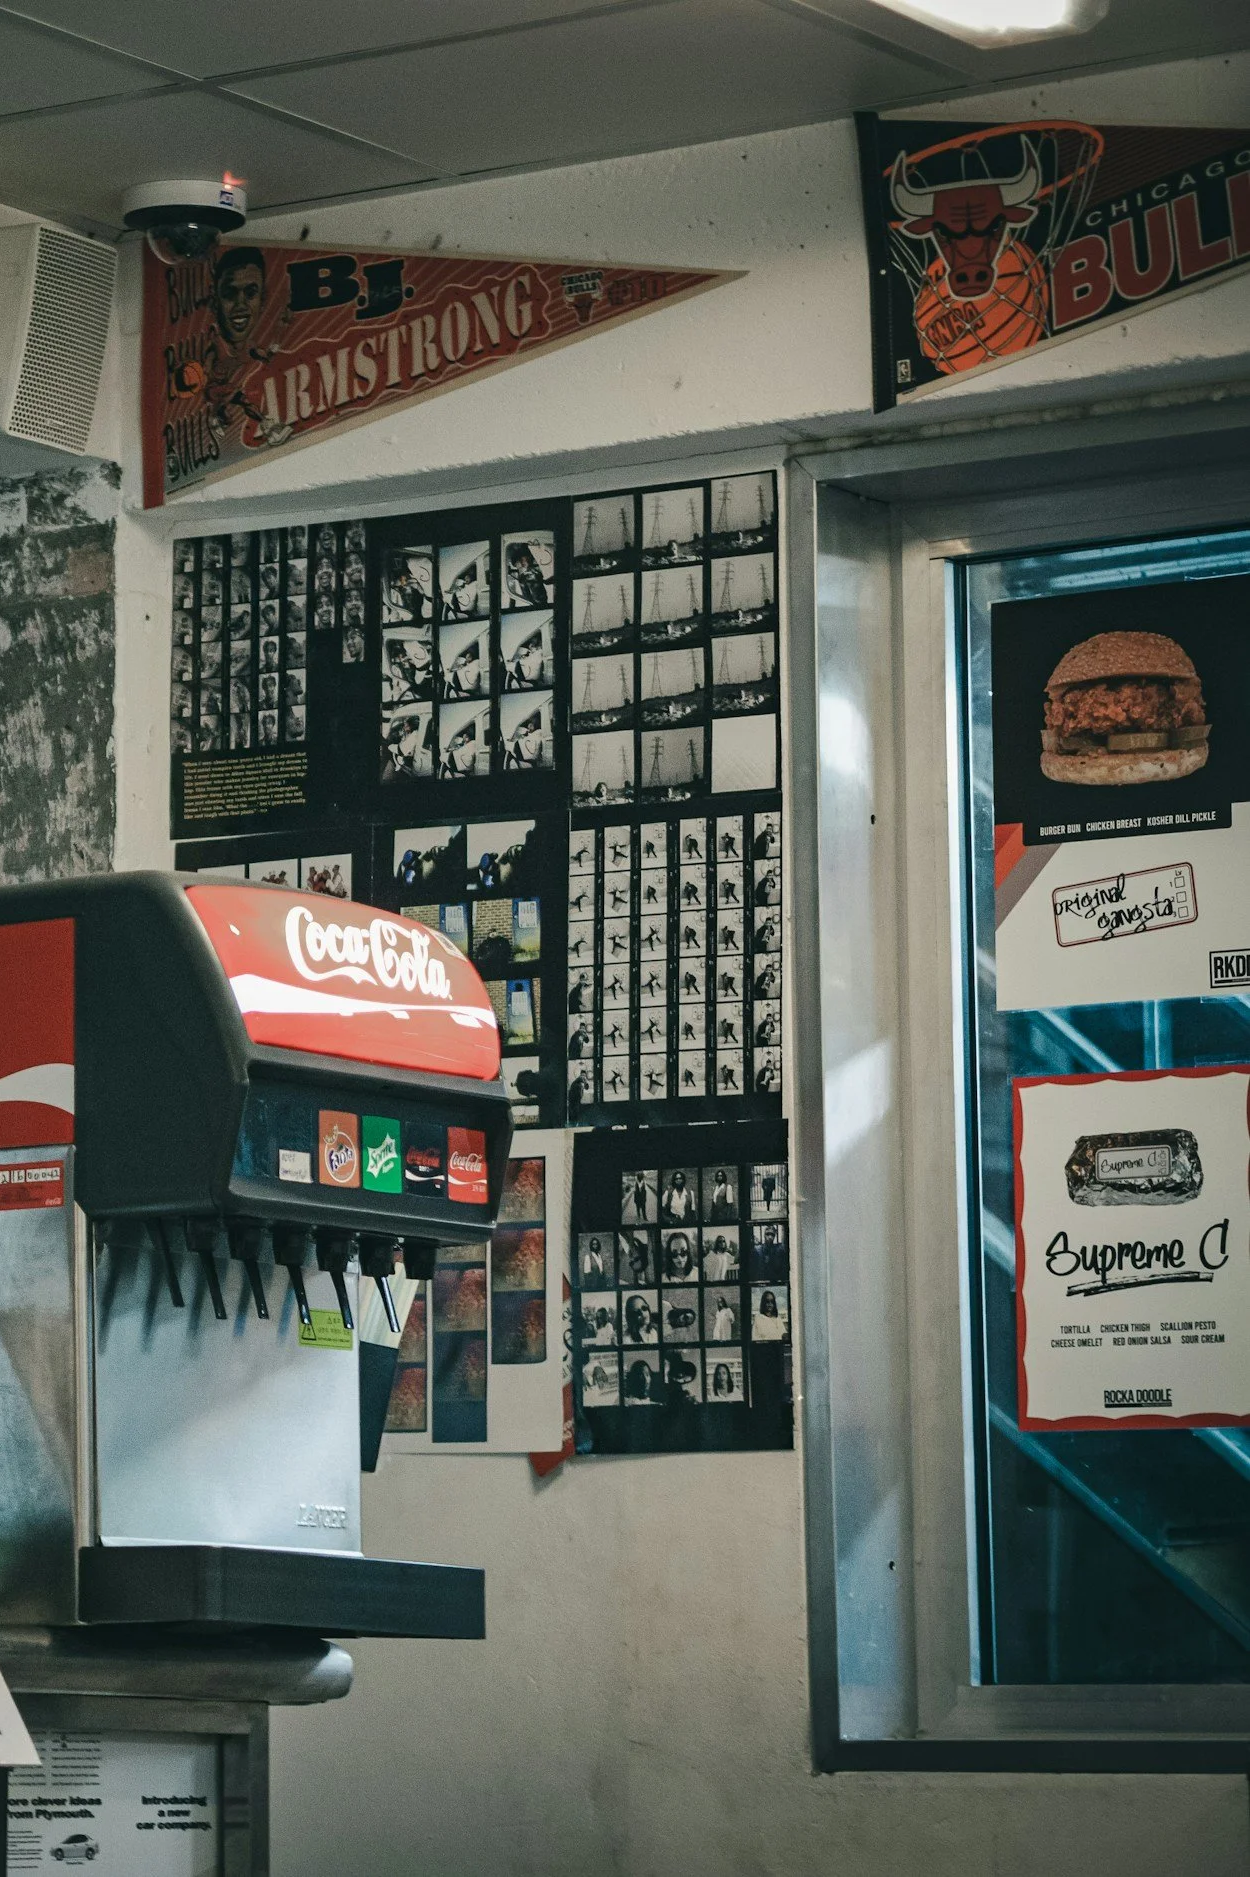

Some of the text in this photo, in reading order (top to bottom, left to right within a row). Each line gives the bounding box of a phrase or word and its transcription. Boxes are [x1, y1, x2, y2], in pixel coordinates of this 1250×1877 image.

[254, 274, 534, 434] ARMSTRONG
[1040, 811, 1217, 836] BURGER BUN CHICKEN BREAST KOSHER DILL PICKLE
[285, 906, 451, 1000] Coca-Cola
[329, 1146, 354, 1172] Fanta
[369, 1141, 395, 1168] Sprite
[1101, 1151, 1156, 1173] Supreme C
[1046, 1218, 1229, 1284] Supreme C
[1060, 1321, 1216, 1334] TORTILLA CHICKEN THIGH SCALLION PESTO
[1051, 1334, 1225, 1348] CHEESE OMELET RED ONION SALSA SOUR CREAM
[1104, 1389, 1172, 1402] ROCKA DOODLE
[32, 1797, 67, 1807] clever
[69, 1797, 102, 1807] ideas
[142, 1796, 207, 1807] Introducing
[36, 1809, 95, 1821] Plymouth.
[136, 1822, 155, 1830] car
